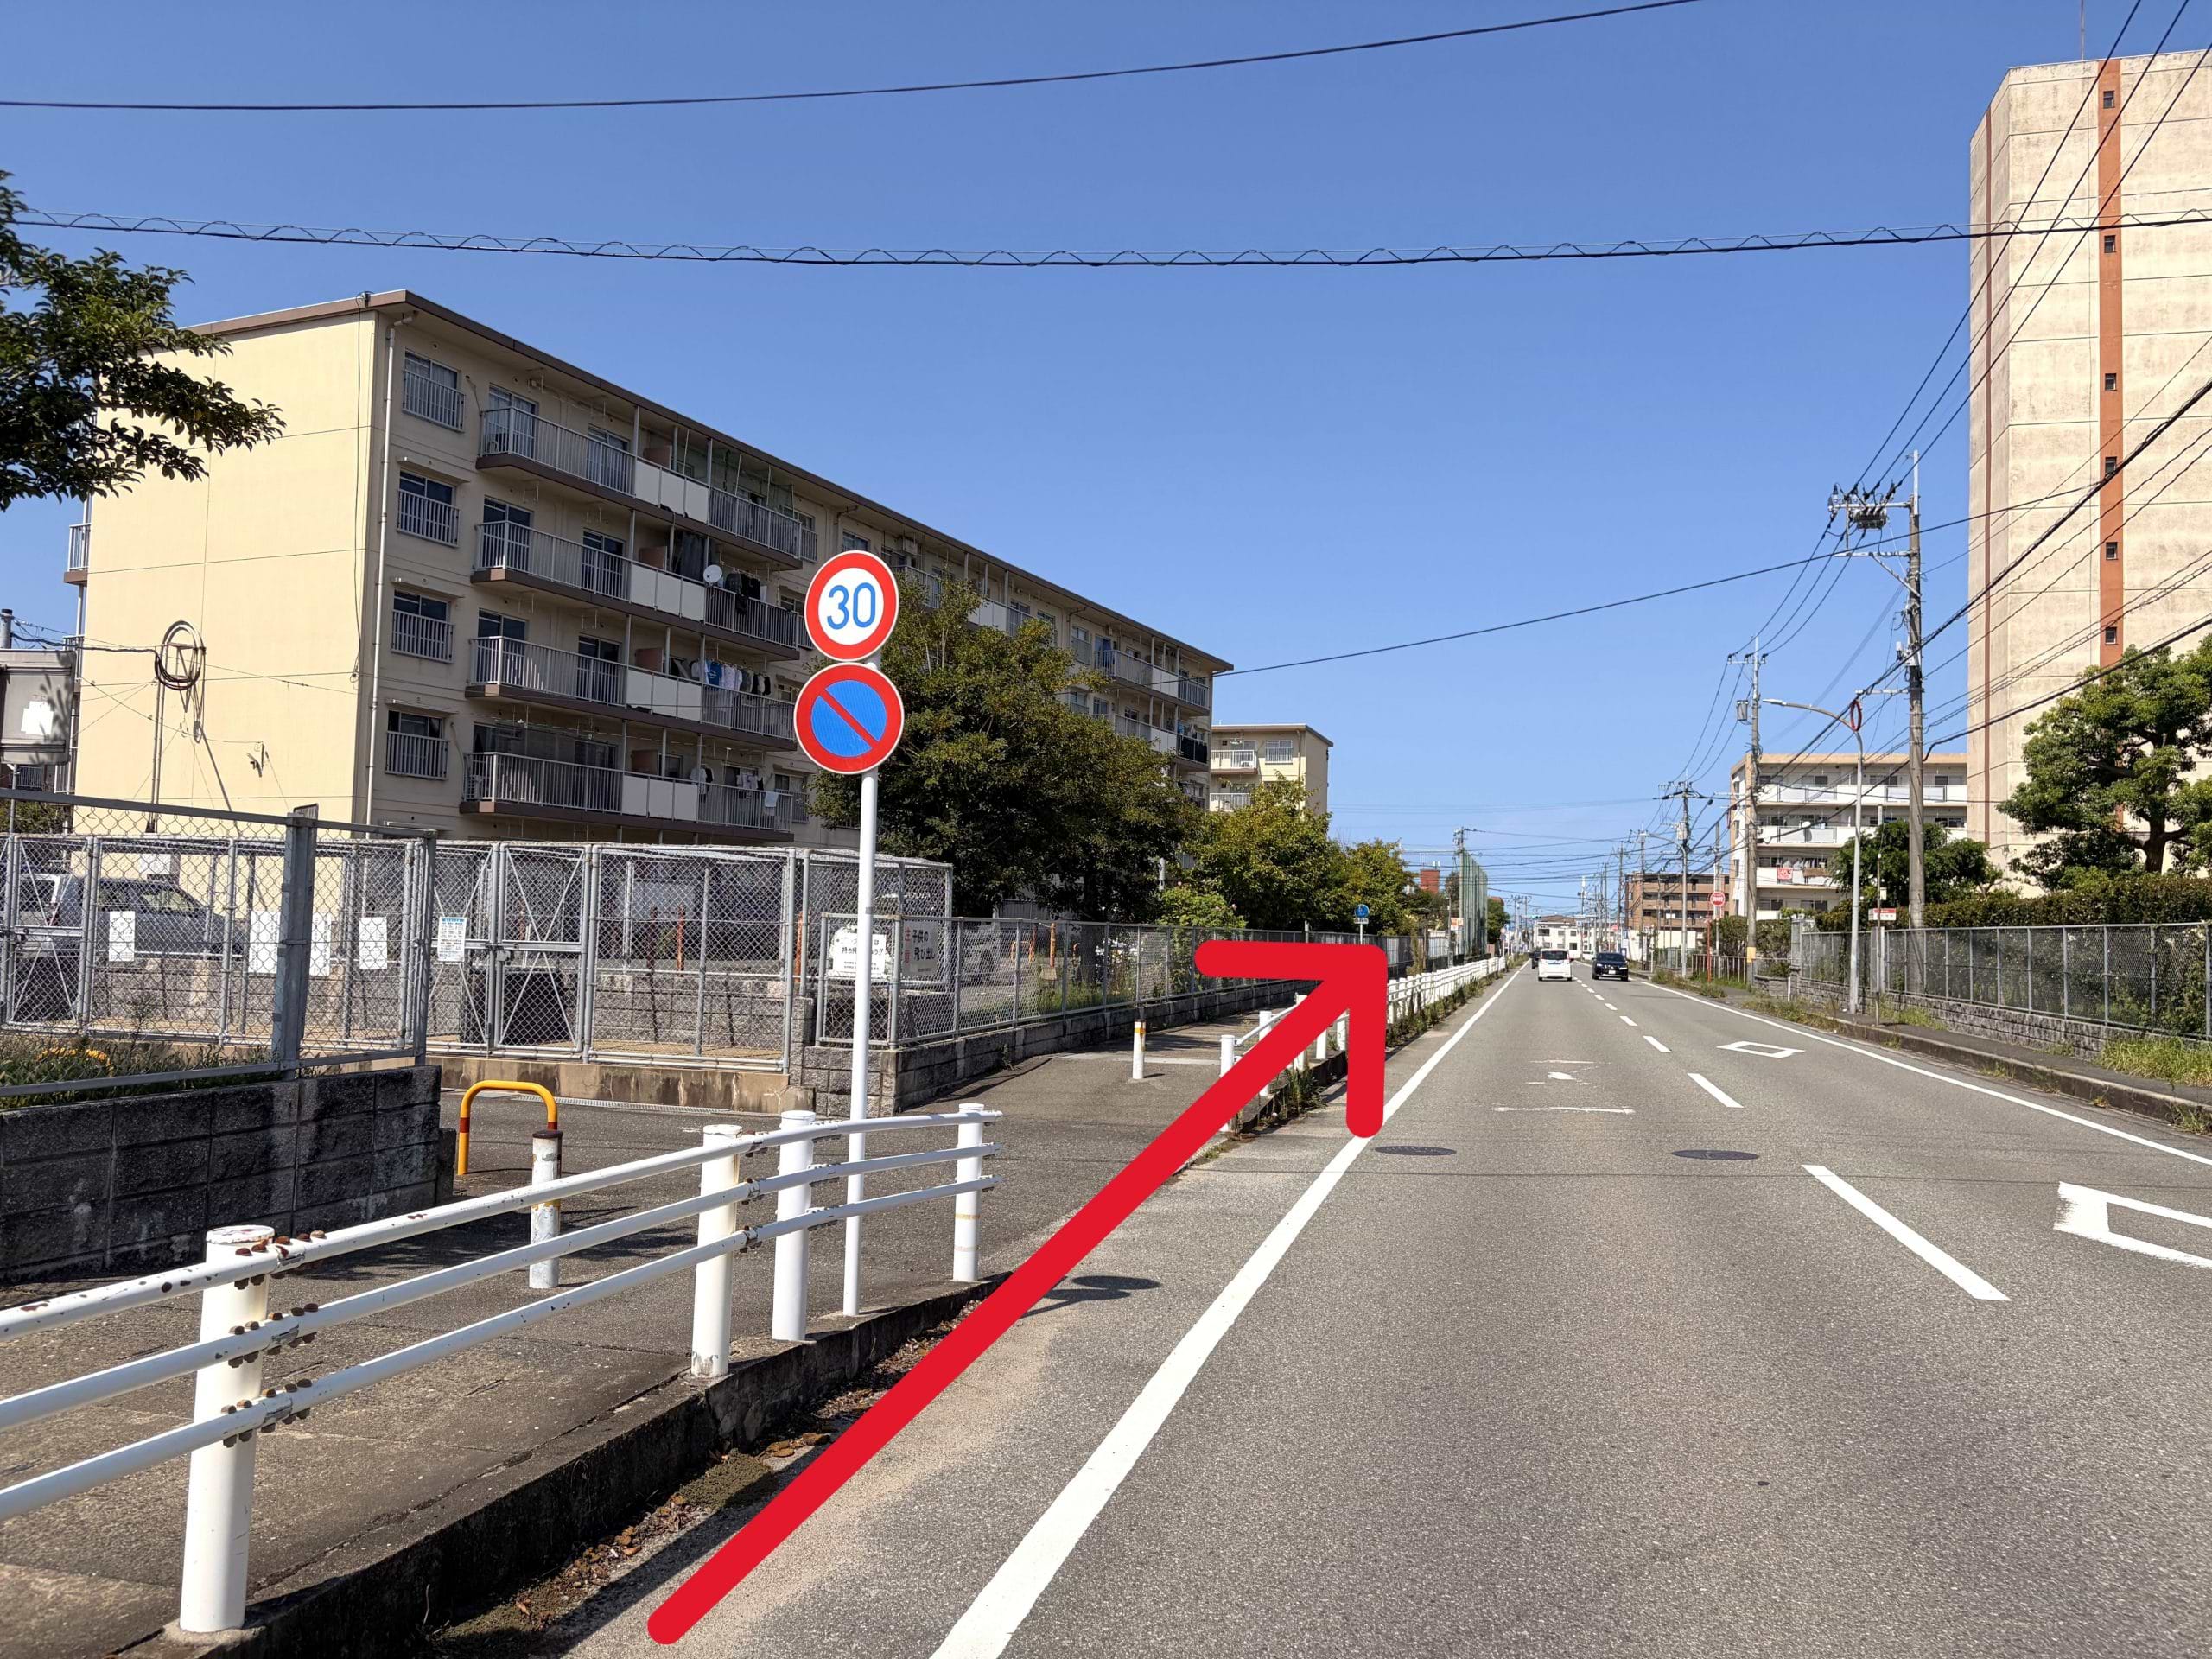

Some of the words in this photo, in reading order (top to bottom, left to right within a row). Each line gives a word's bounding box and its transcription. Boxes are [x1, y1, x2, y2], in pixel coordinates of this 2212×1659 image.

[827, 582, 875, 630] 30
[912, 930, 929, 943] 子供の
[914, 947, 936, 961] 飛び出し
